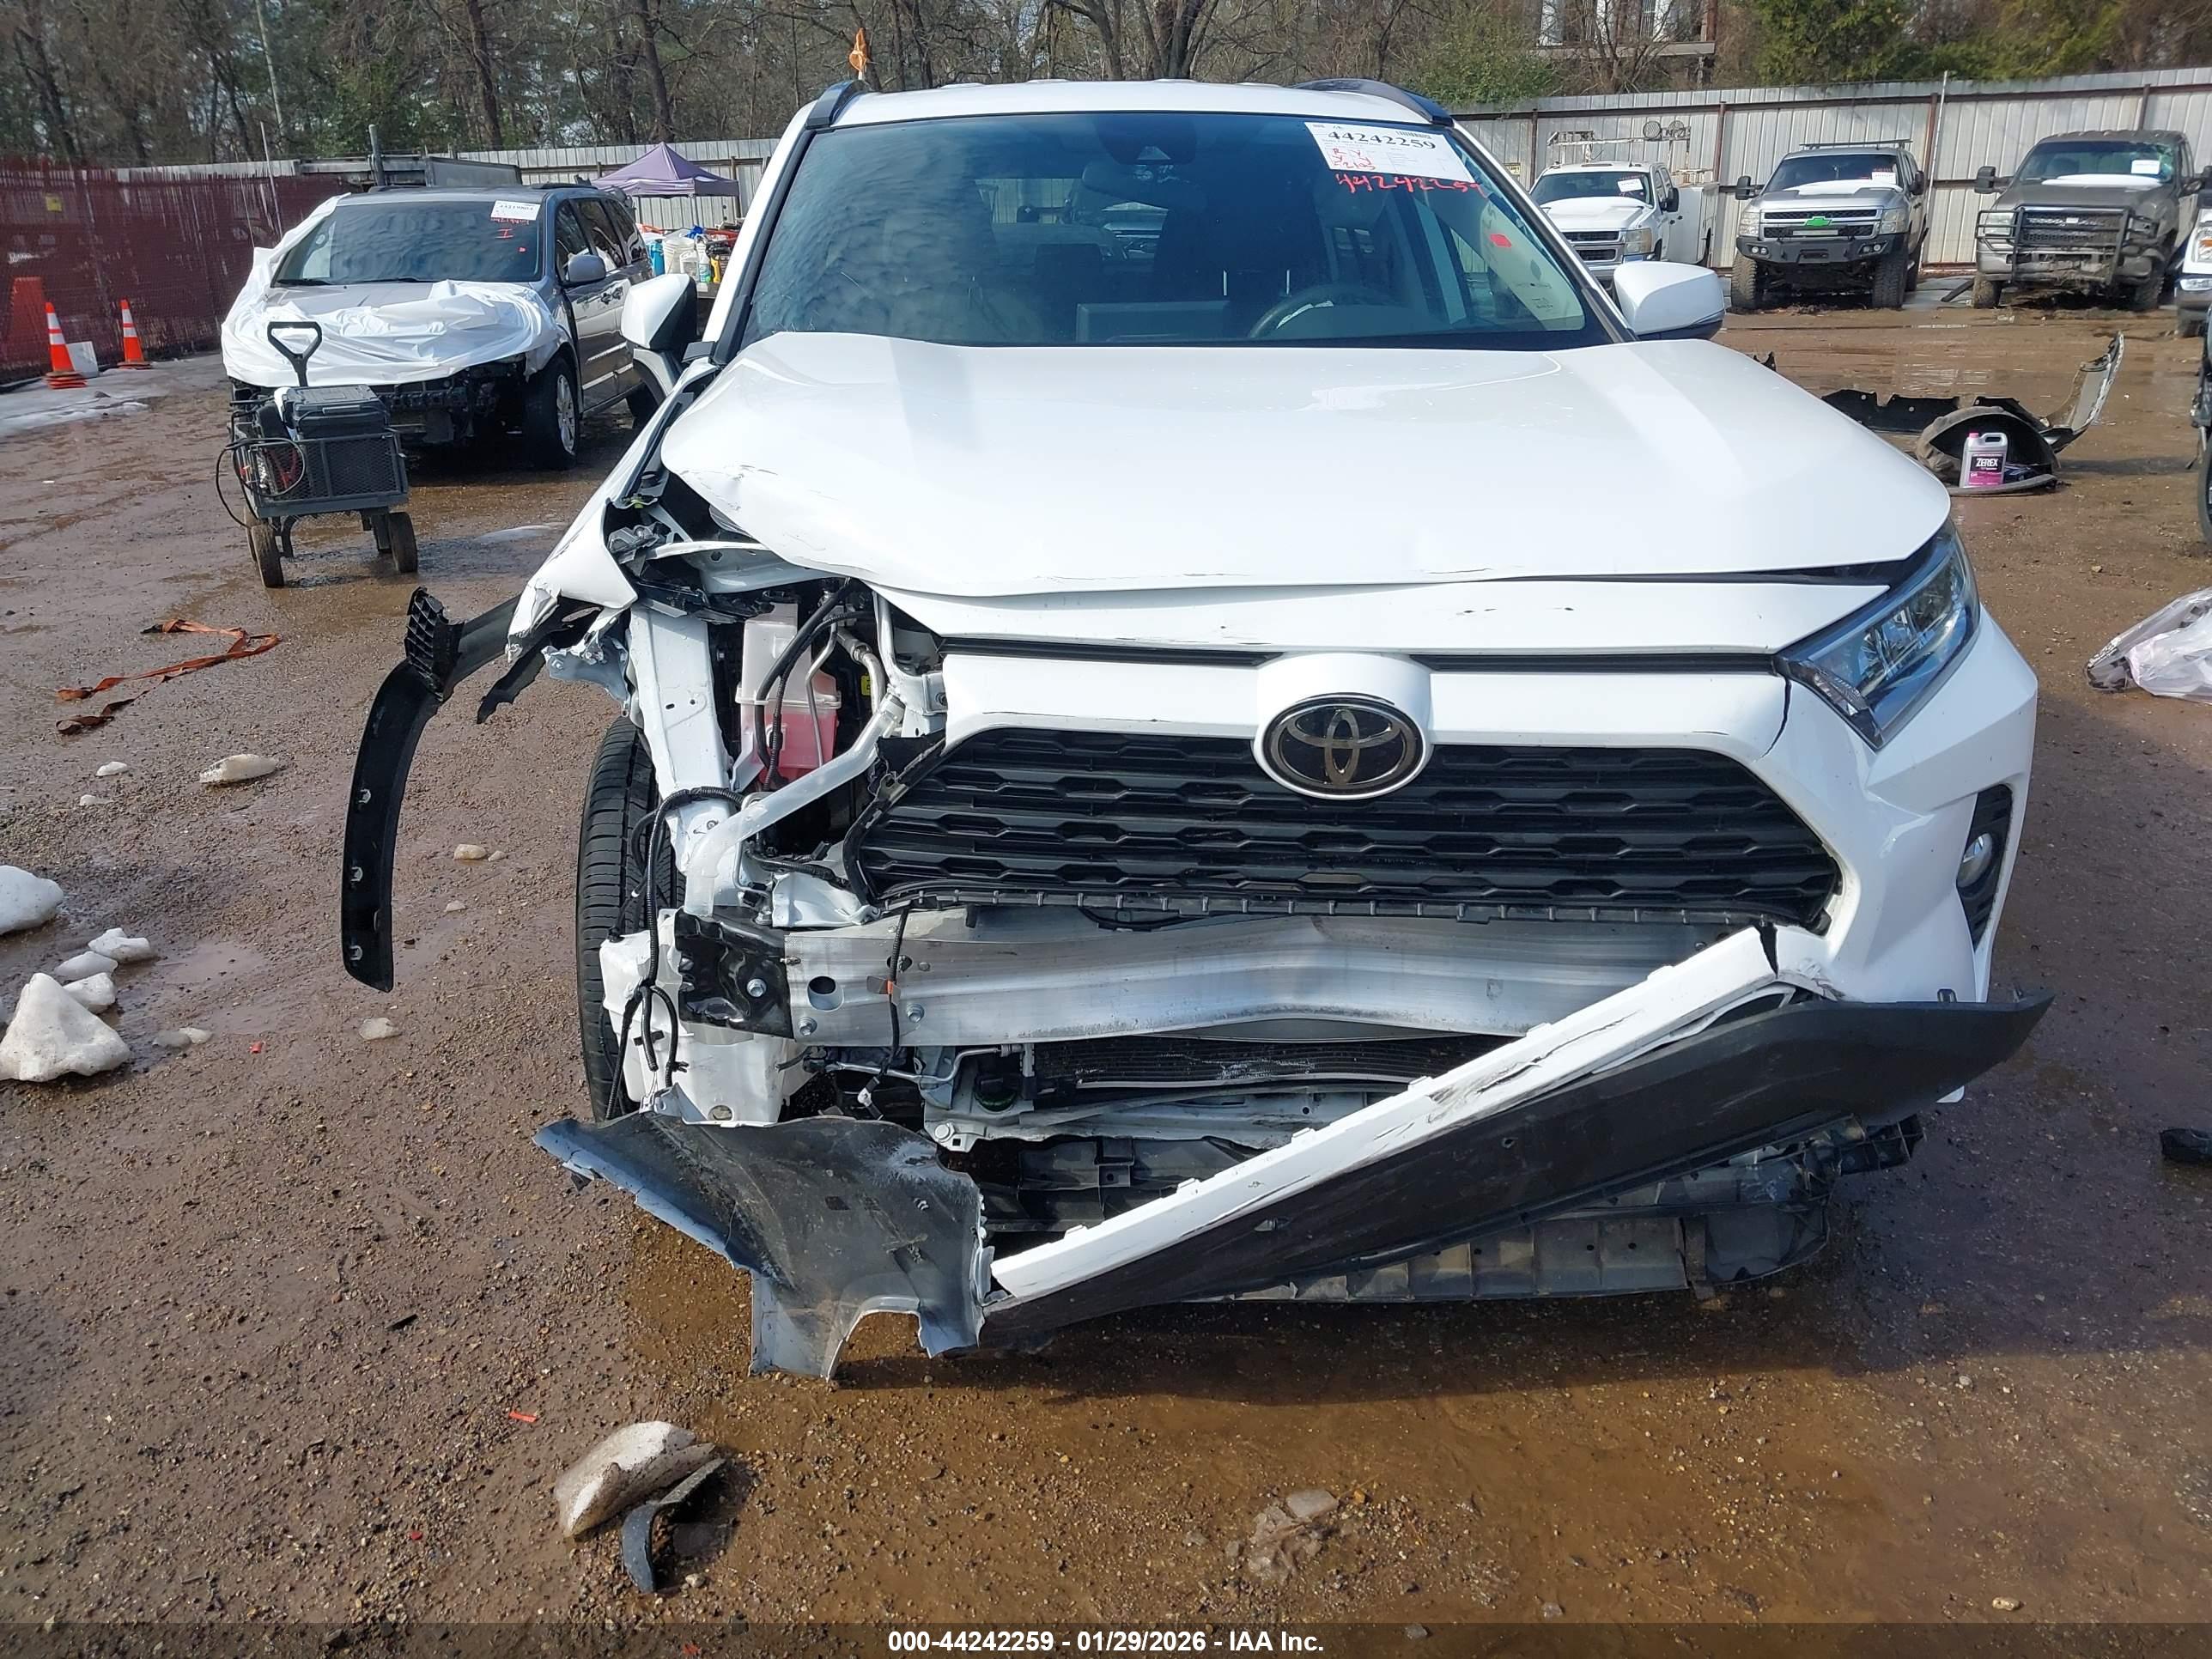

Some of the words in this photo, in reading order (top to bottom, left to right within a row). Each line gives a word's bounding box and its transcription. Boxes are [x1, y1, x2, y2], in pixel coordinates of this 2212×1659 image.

[1328, 131, 1437, 149] 44242259
[1335, 173, 1488, 198] 44242259
[1976, 459, 1998, 467] ZEREX
